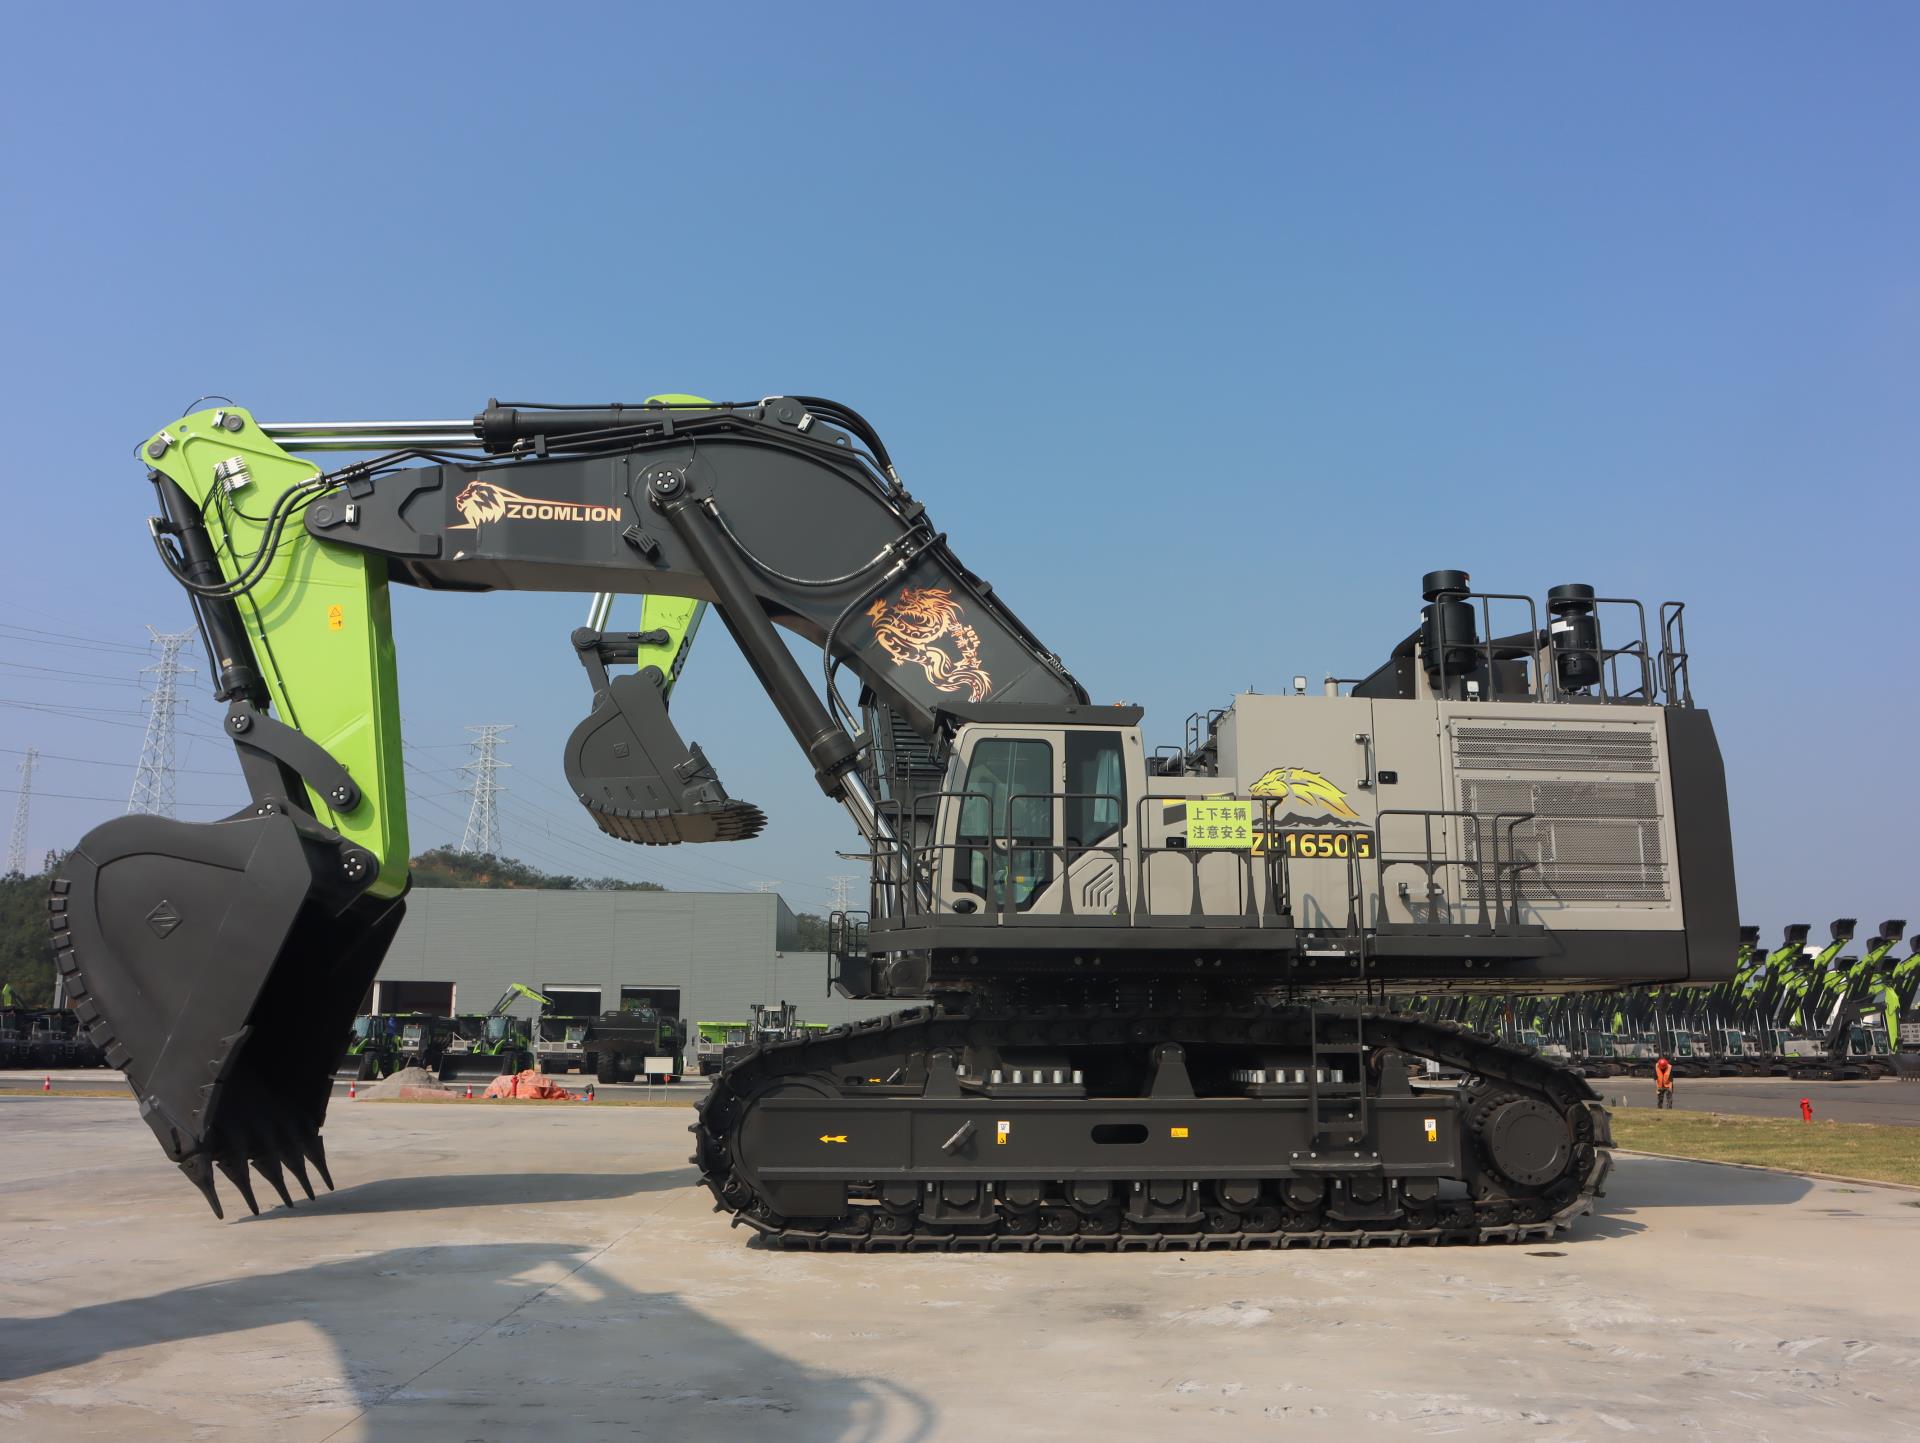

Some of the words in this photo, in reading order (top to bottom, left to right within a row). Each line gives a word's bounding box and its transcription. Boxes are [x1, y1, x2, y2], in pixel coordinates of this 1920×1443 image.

[507, 504, 621, 522] ZOOMLION
[1192, 807, 1247, 821] 上下车辆
[1193, 825, 1247, 839] 注意安全
